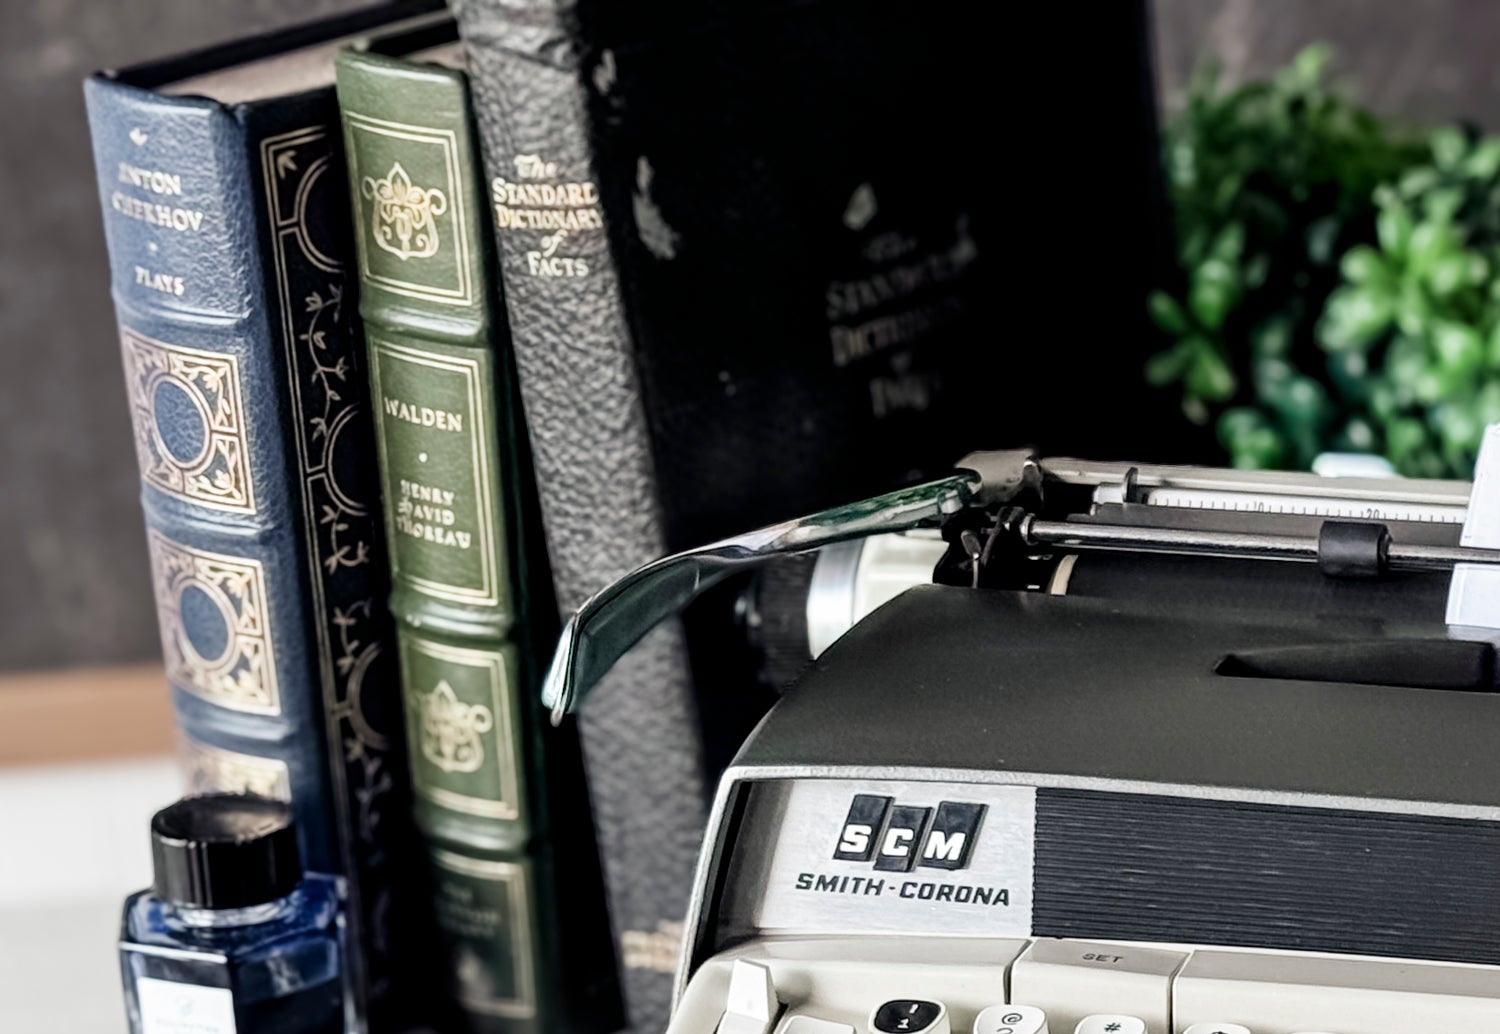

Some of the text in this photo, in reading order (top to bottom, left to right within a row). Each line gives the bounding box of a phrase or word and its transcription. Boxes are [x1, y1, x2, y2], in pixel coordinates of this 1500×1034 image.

[526, 250, 589, 278] FACTS
[384, 397, 462, 433] WALDEN
[838, 824, 967, 861] SCM
[1082, 952, 1125, 963] SET
[1001, 1012, 1023, 1025] @
[1104, 1021, 1122, 1033] #
